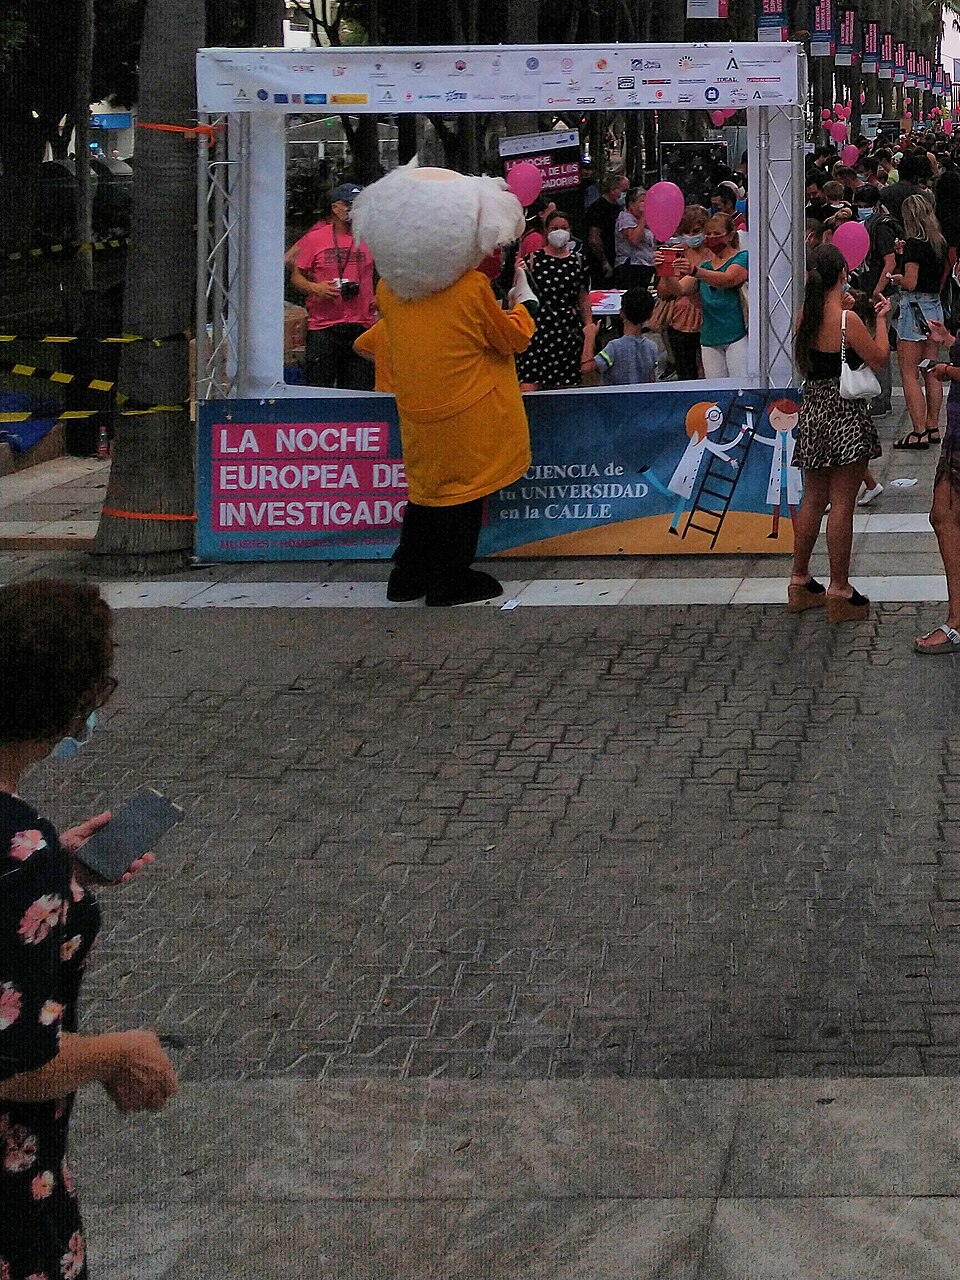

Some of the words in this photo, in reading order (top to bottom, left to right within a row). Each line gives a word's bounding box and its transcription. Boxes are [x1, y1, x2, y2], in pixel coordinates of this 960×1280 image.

[220, 429, 260, 453] LA
[276, 427, 381, 453] NOCHE
[219, 464, 360, 490] EUROPEA
[372, 463, 409, 489] DE
[522, 463, 601, 480] CIENCIA
[604, 461, 624, 477] de
[521, 483, 649, 500] UNIVERSIDAD
[219, 500, 409, 526] INVESTIGADO
[500, 507, 520, 520] en
[524, 504, 540, 520] la
[544, 503, 613, 520] CALLE
